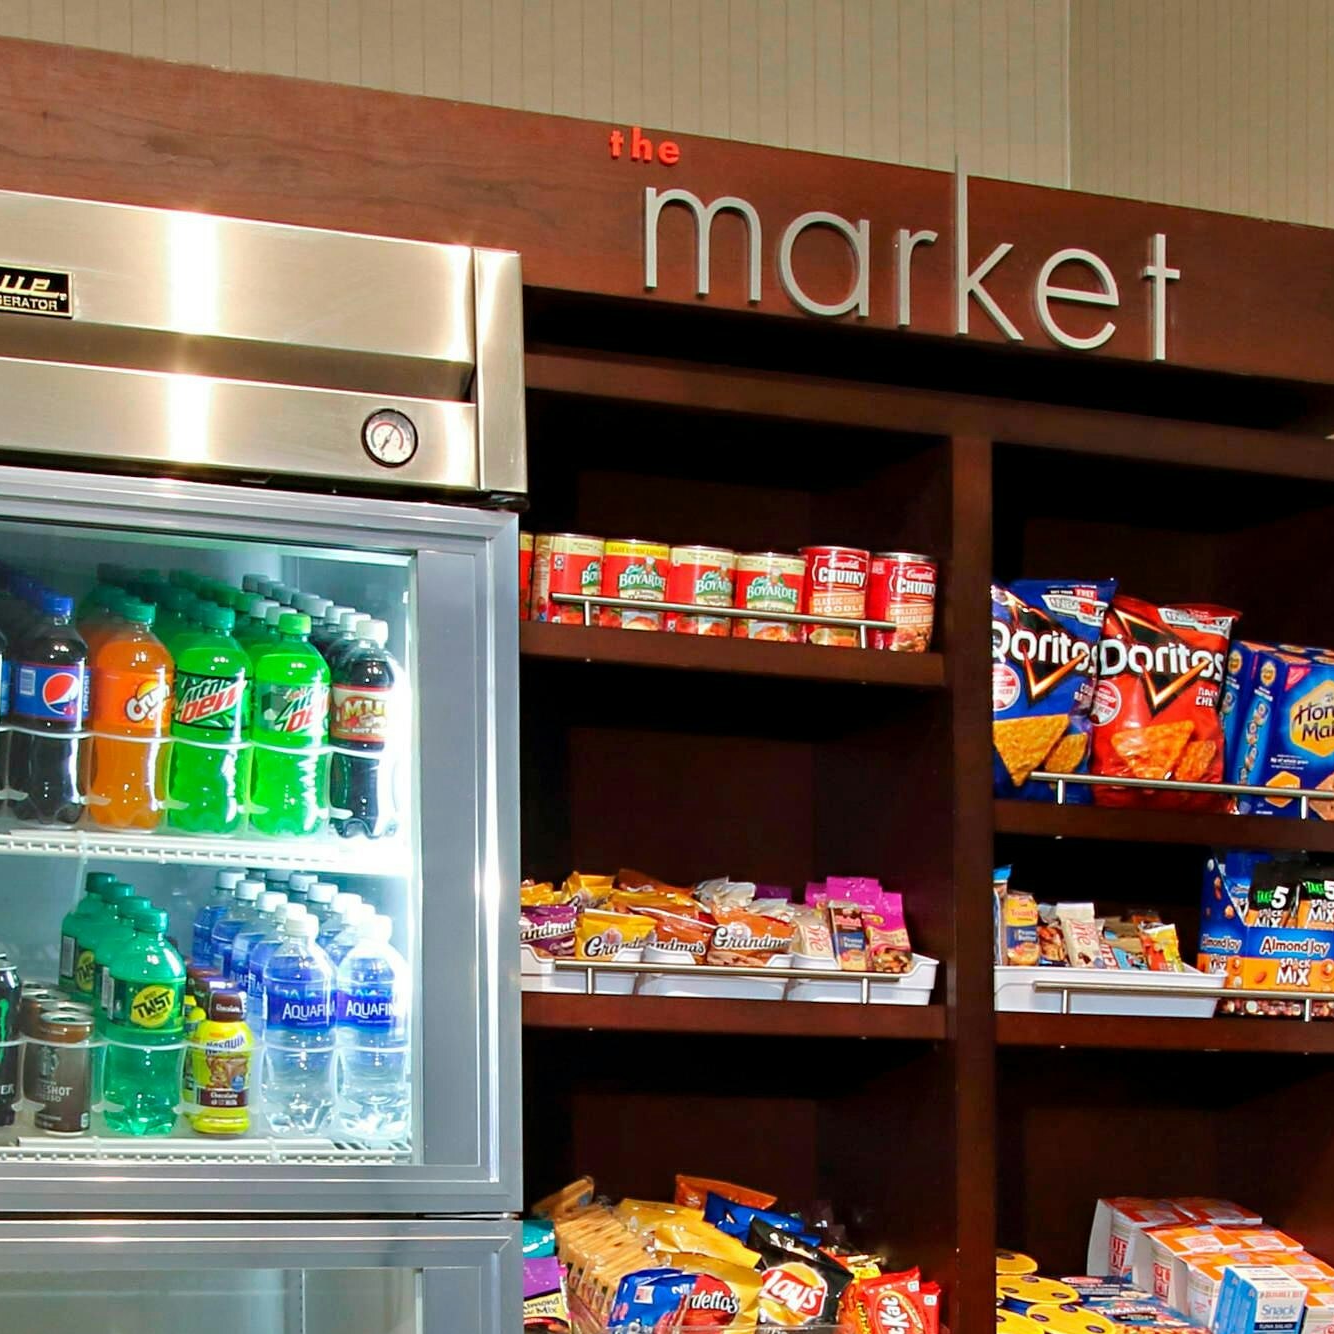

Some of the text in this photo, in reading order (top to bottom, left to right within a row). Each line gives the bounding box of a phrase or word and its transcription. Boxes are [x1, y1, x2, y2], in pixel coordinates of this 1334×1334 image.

[610, 127, 681, 165] the
[645, 154, 1181, 361] market
[818, 567, 866, 587] CHUNKY
[747, 585, 798, 602] BOYARDEE
[814, 604, 865, 614] NOODLE
[1099, 638, 1225, 682] Doritos
[1270, 887, 1289, 909] 5
[1279, 957, 1311, 969] SNACK
[1276, 966, 1309, 987] MIX
[132, 989, 173, 1020] TWIST
[761, 1270, 825, 1312] Lay's
[1261, 1304, 1295, 1315] Snack
